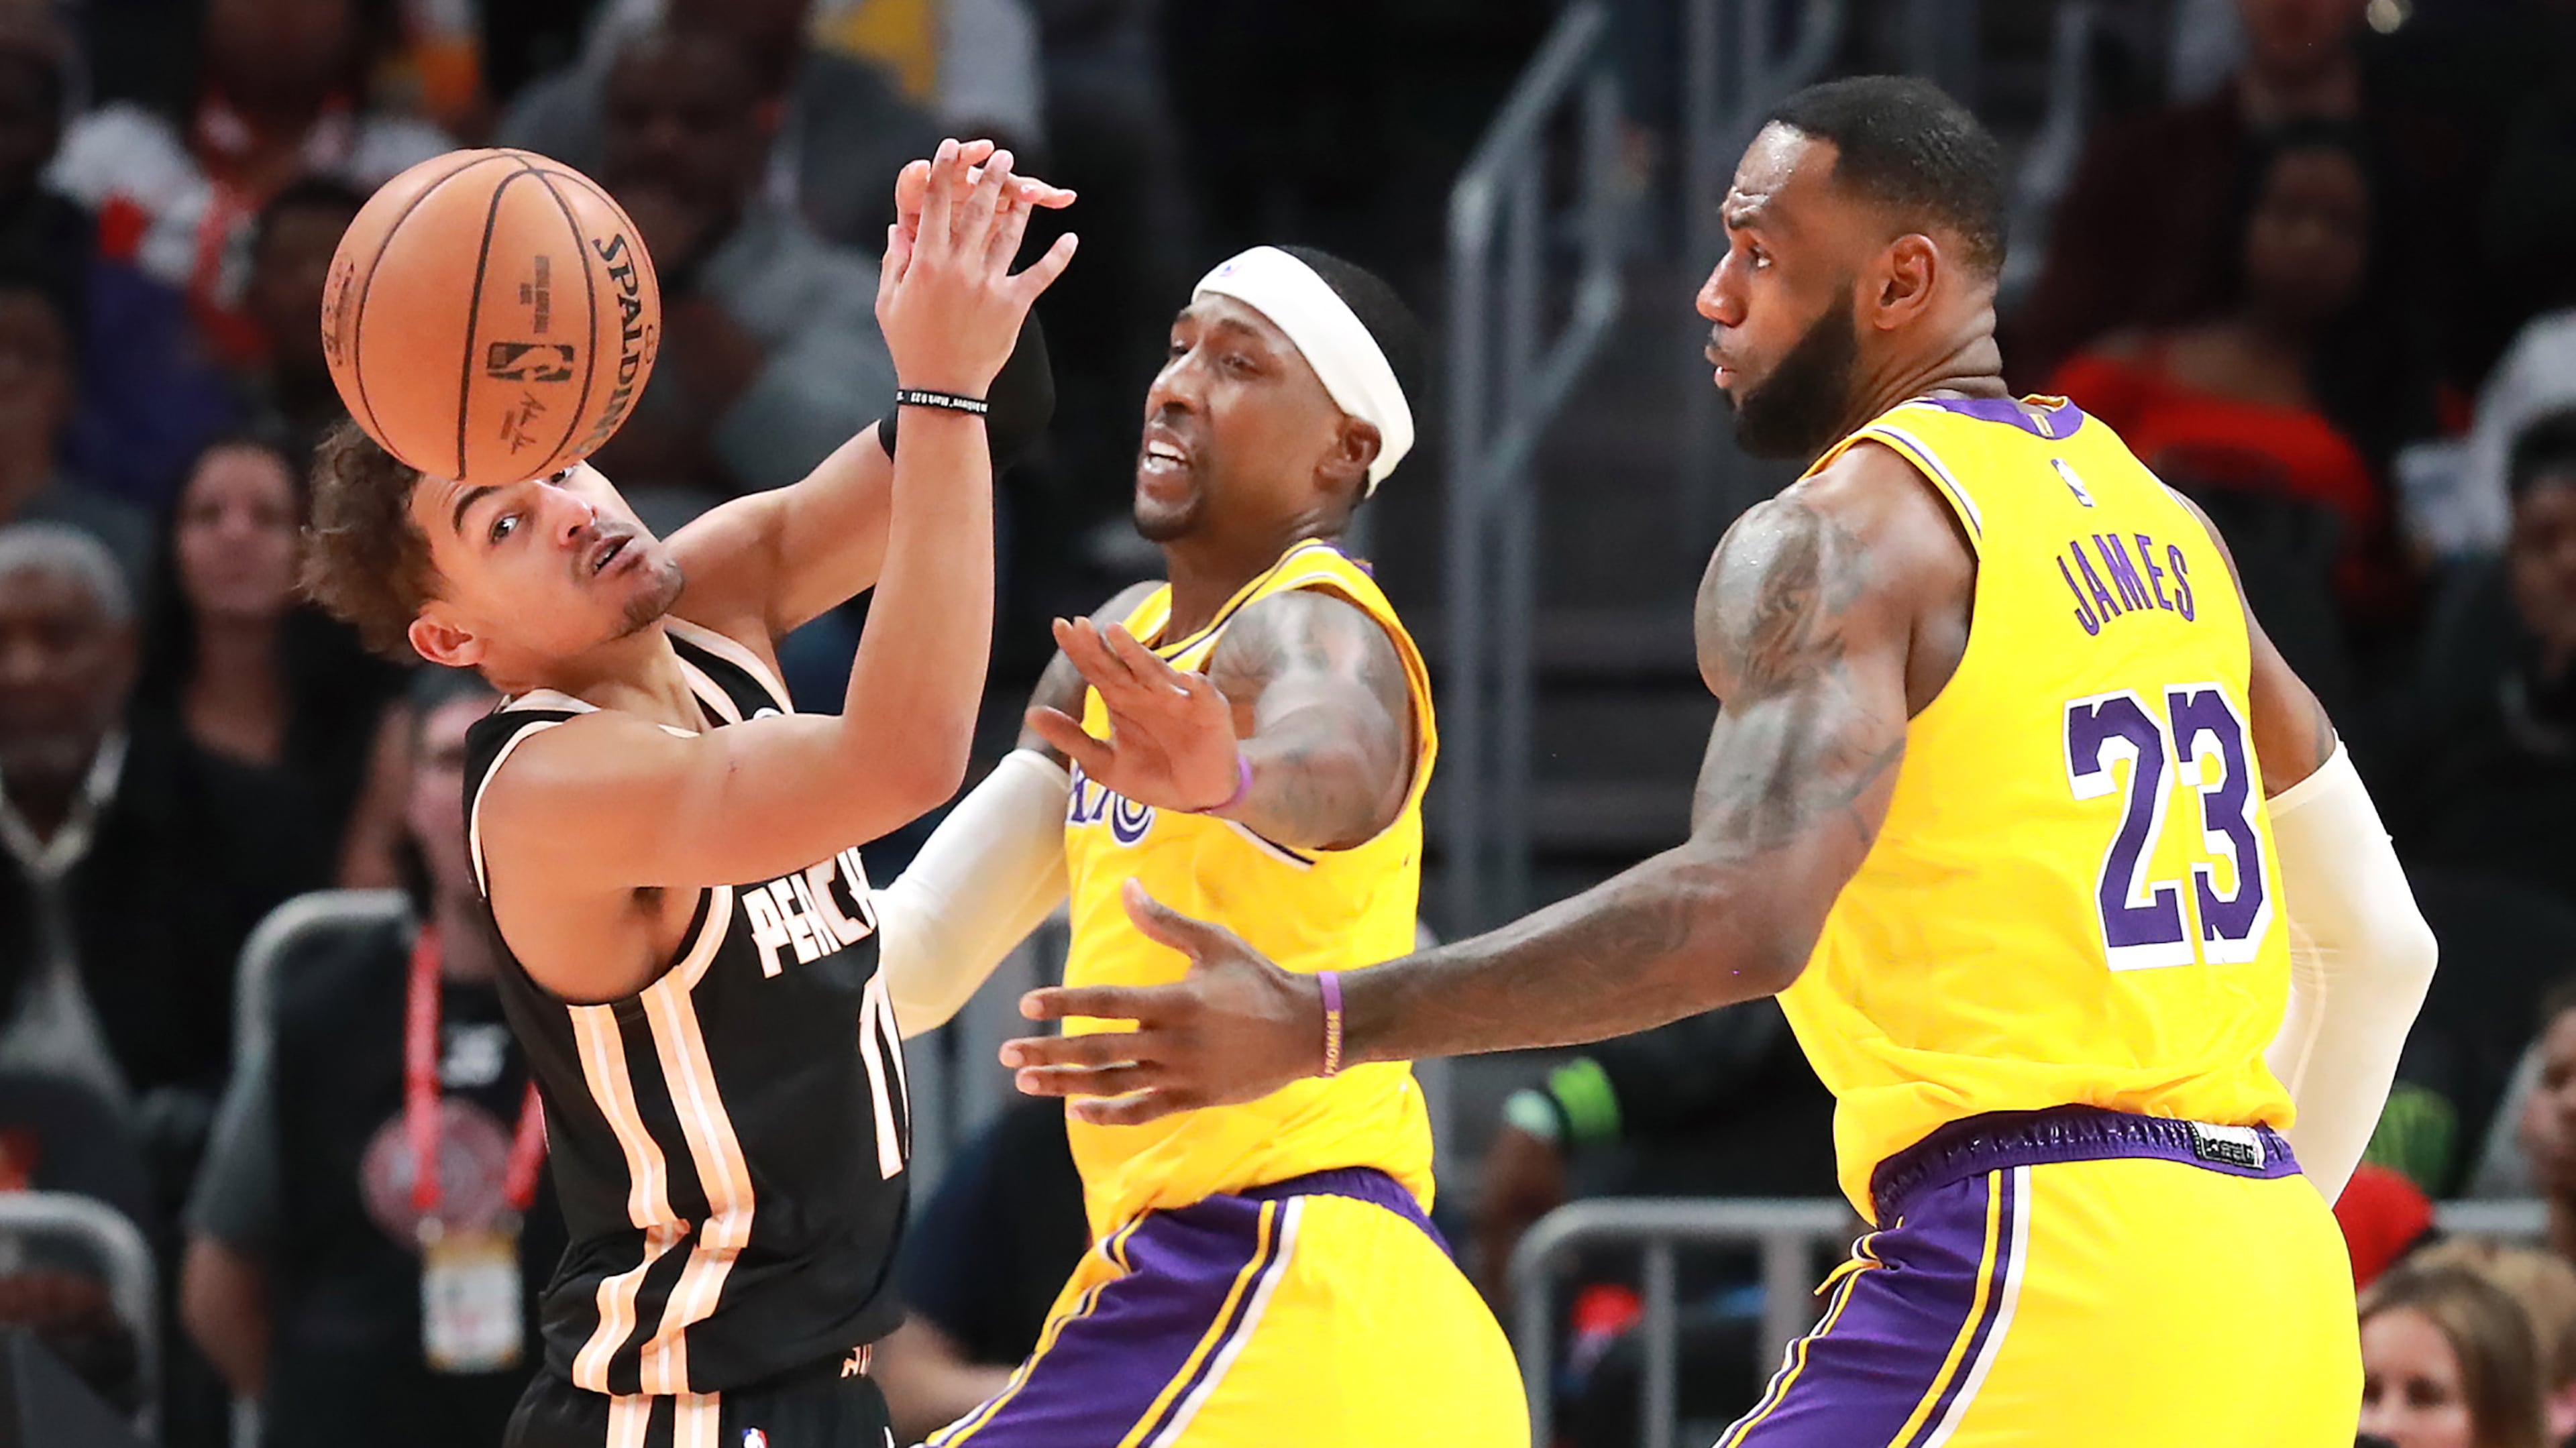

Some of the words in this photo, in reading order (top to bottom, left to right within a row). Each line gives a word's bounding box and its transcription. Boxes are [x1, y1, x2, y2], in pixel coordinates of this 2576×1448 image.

[572, 233, 642, 455] SPALDING
[2056, 533, 2194, 636] JAMES
[2063, 682, 2273, 972] 23
[1324, 1009, 1341, 1075] PROMISE
